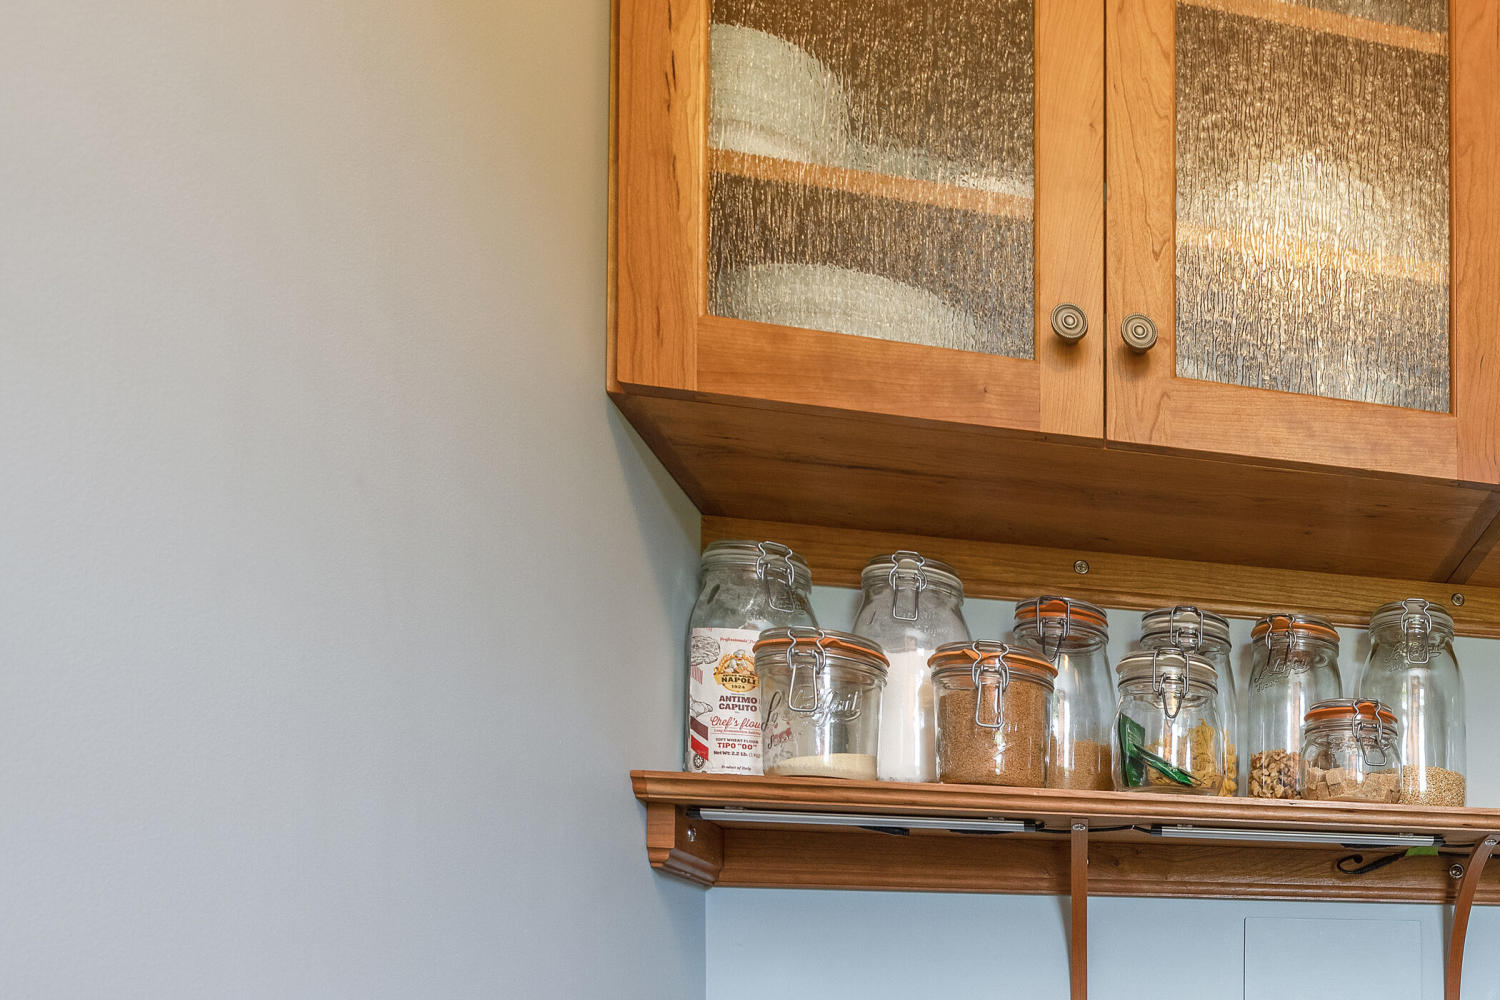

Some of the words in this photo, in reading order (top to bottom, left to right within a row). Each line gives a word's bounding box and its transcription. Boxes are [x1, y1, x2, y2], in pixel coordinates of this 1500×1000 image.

[721, 677, 756, 685] NAPOLI
[719, 695, 758, 705] ANTIMO
[719, 703, 758, 712] CAPUTO
[710, 715, 739, 729] Chef's
[739, 717, 761, 730] flou
